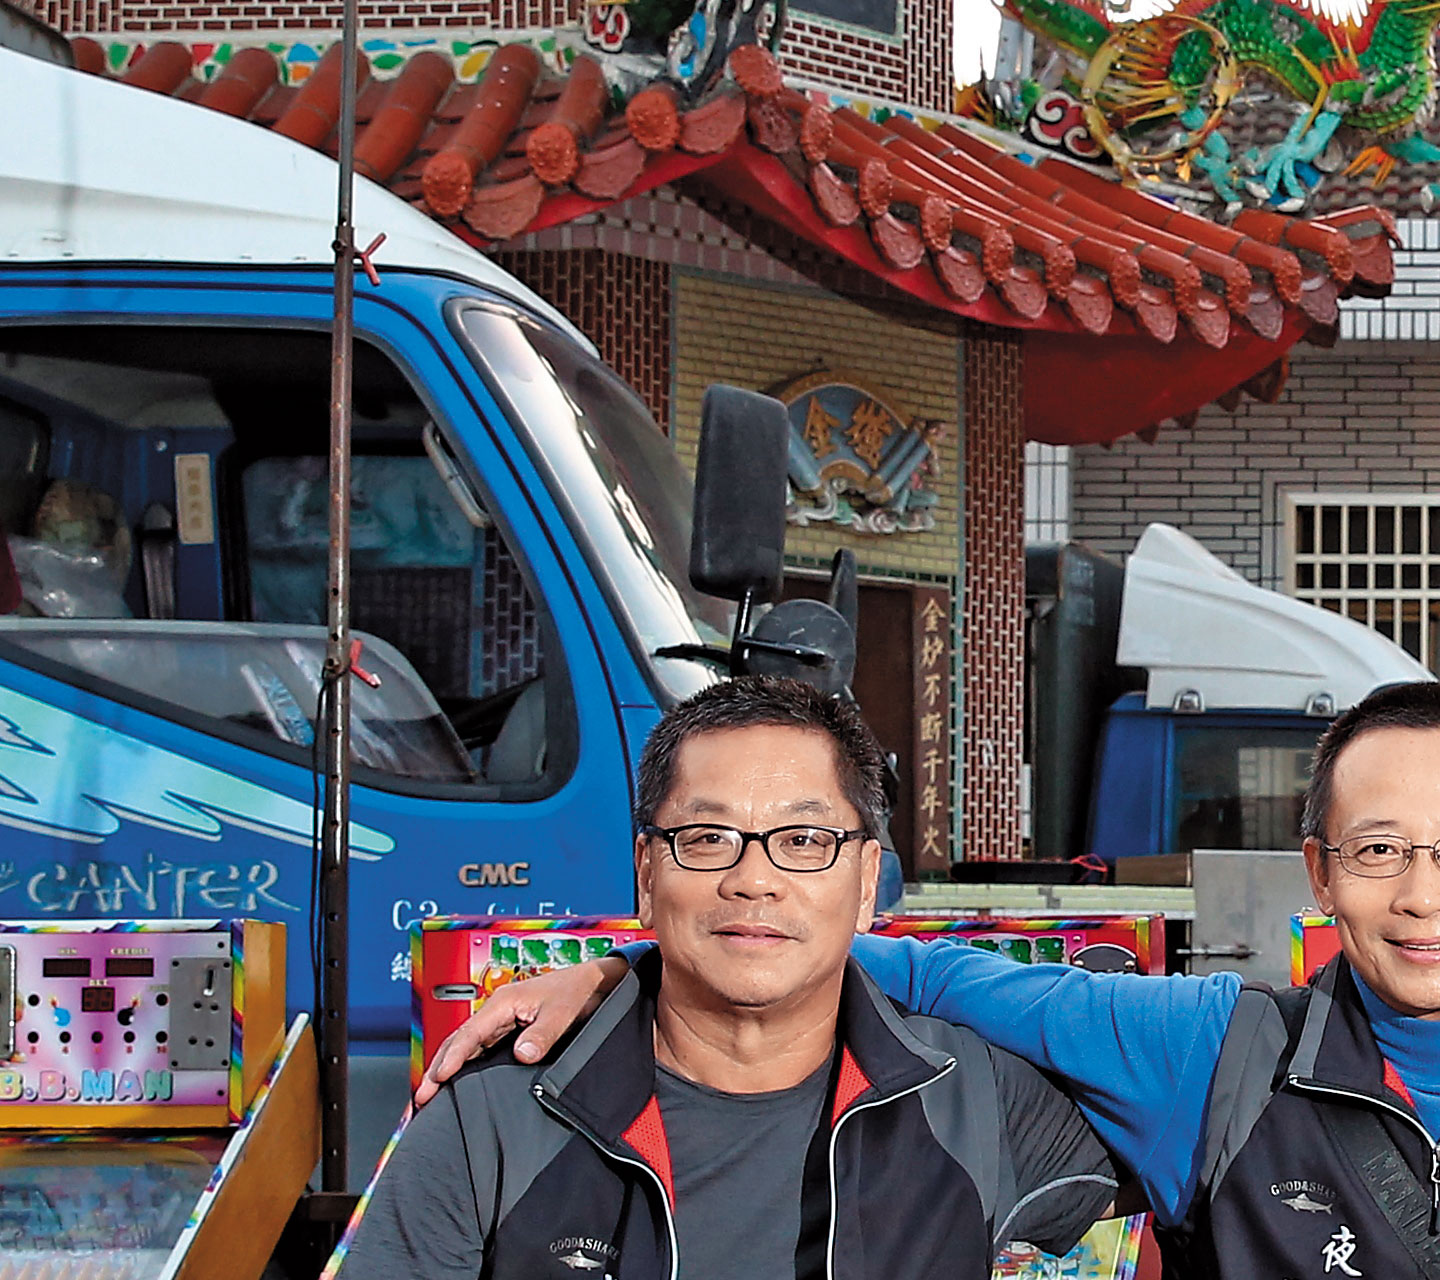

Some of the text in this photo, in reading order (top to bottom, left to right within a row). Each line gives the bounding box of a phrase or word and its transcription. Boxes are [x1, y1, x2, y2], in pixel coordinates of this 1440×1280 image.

[27, 852, 302, 917] CANTER
[458, 862, 530, 887] CMC
[1271, 1180, 1337, 1199] GOOD&SHA
